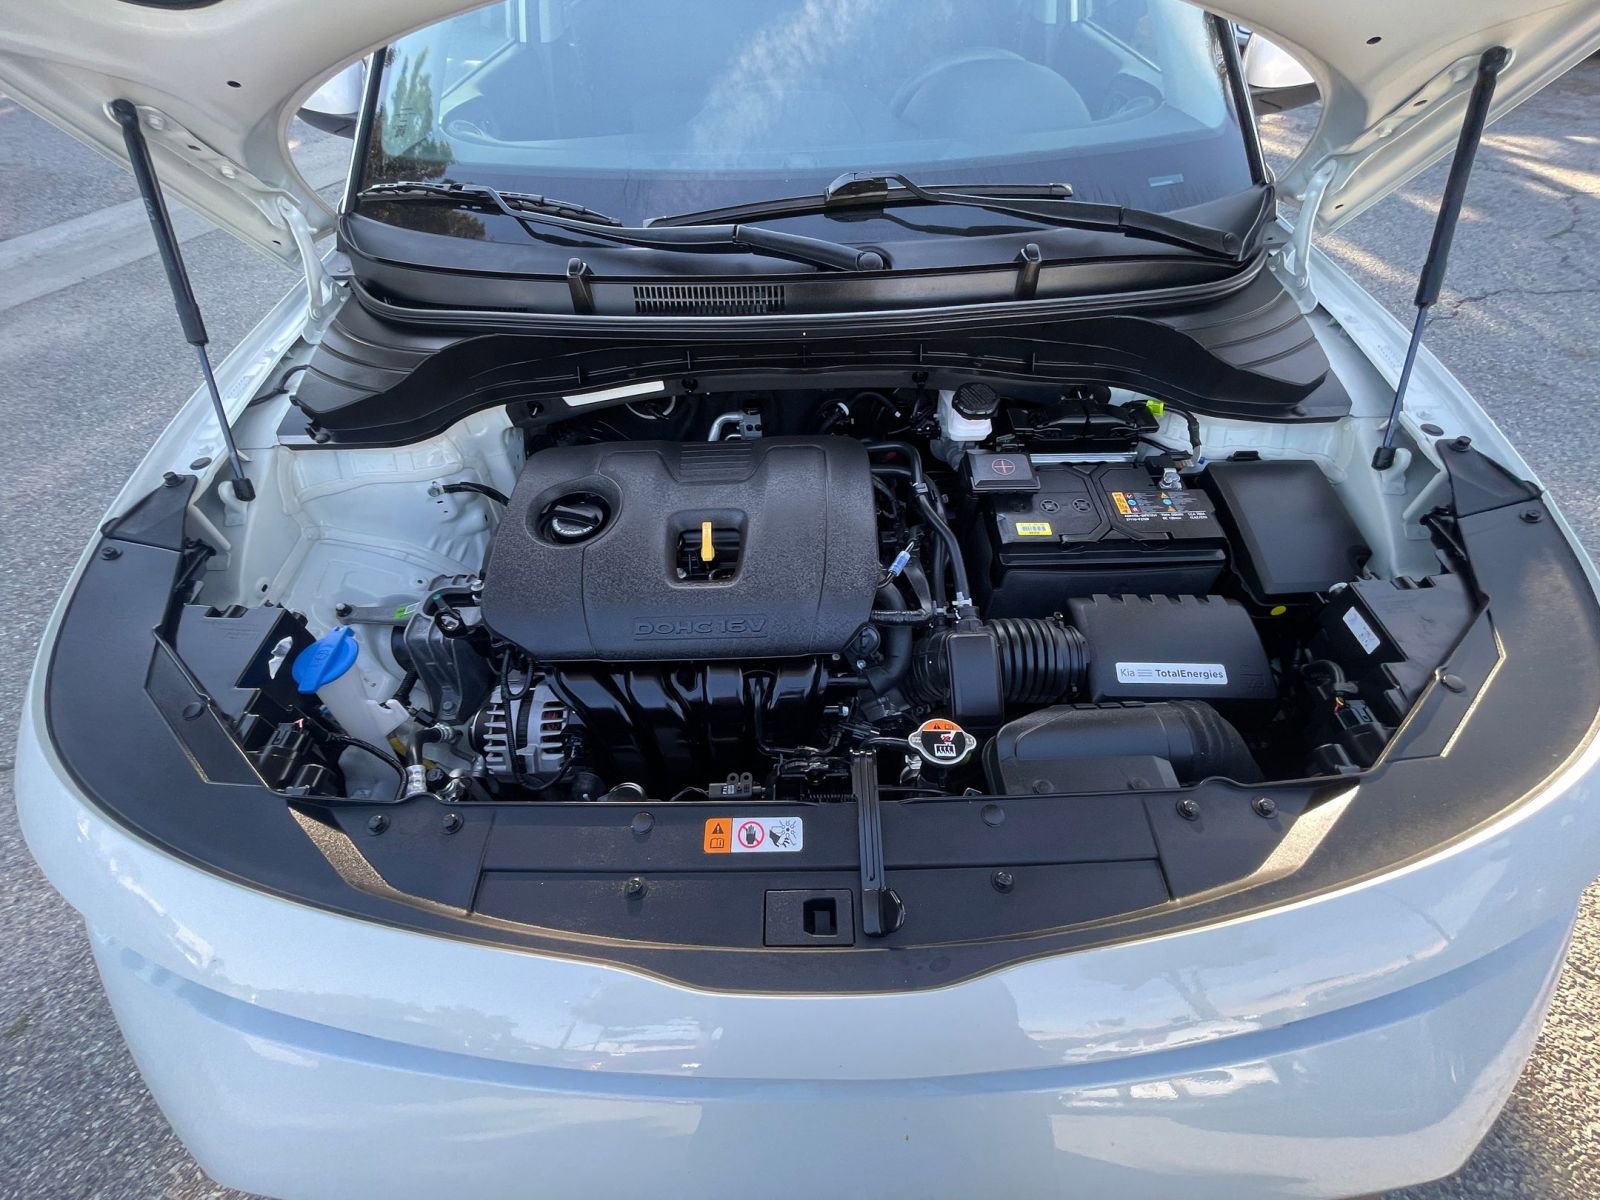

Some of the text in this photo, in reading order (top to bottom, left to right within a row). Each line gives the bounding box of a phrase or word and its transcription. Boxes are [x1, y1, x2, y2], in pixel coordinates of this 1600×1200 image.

[635, 618, 766, 635] DOHC 16V
[1120, 668, 1224, 680] Kia TotalEnergies
